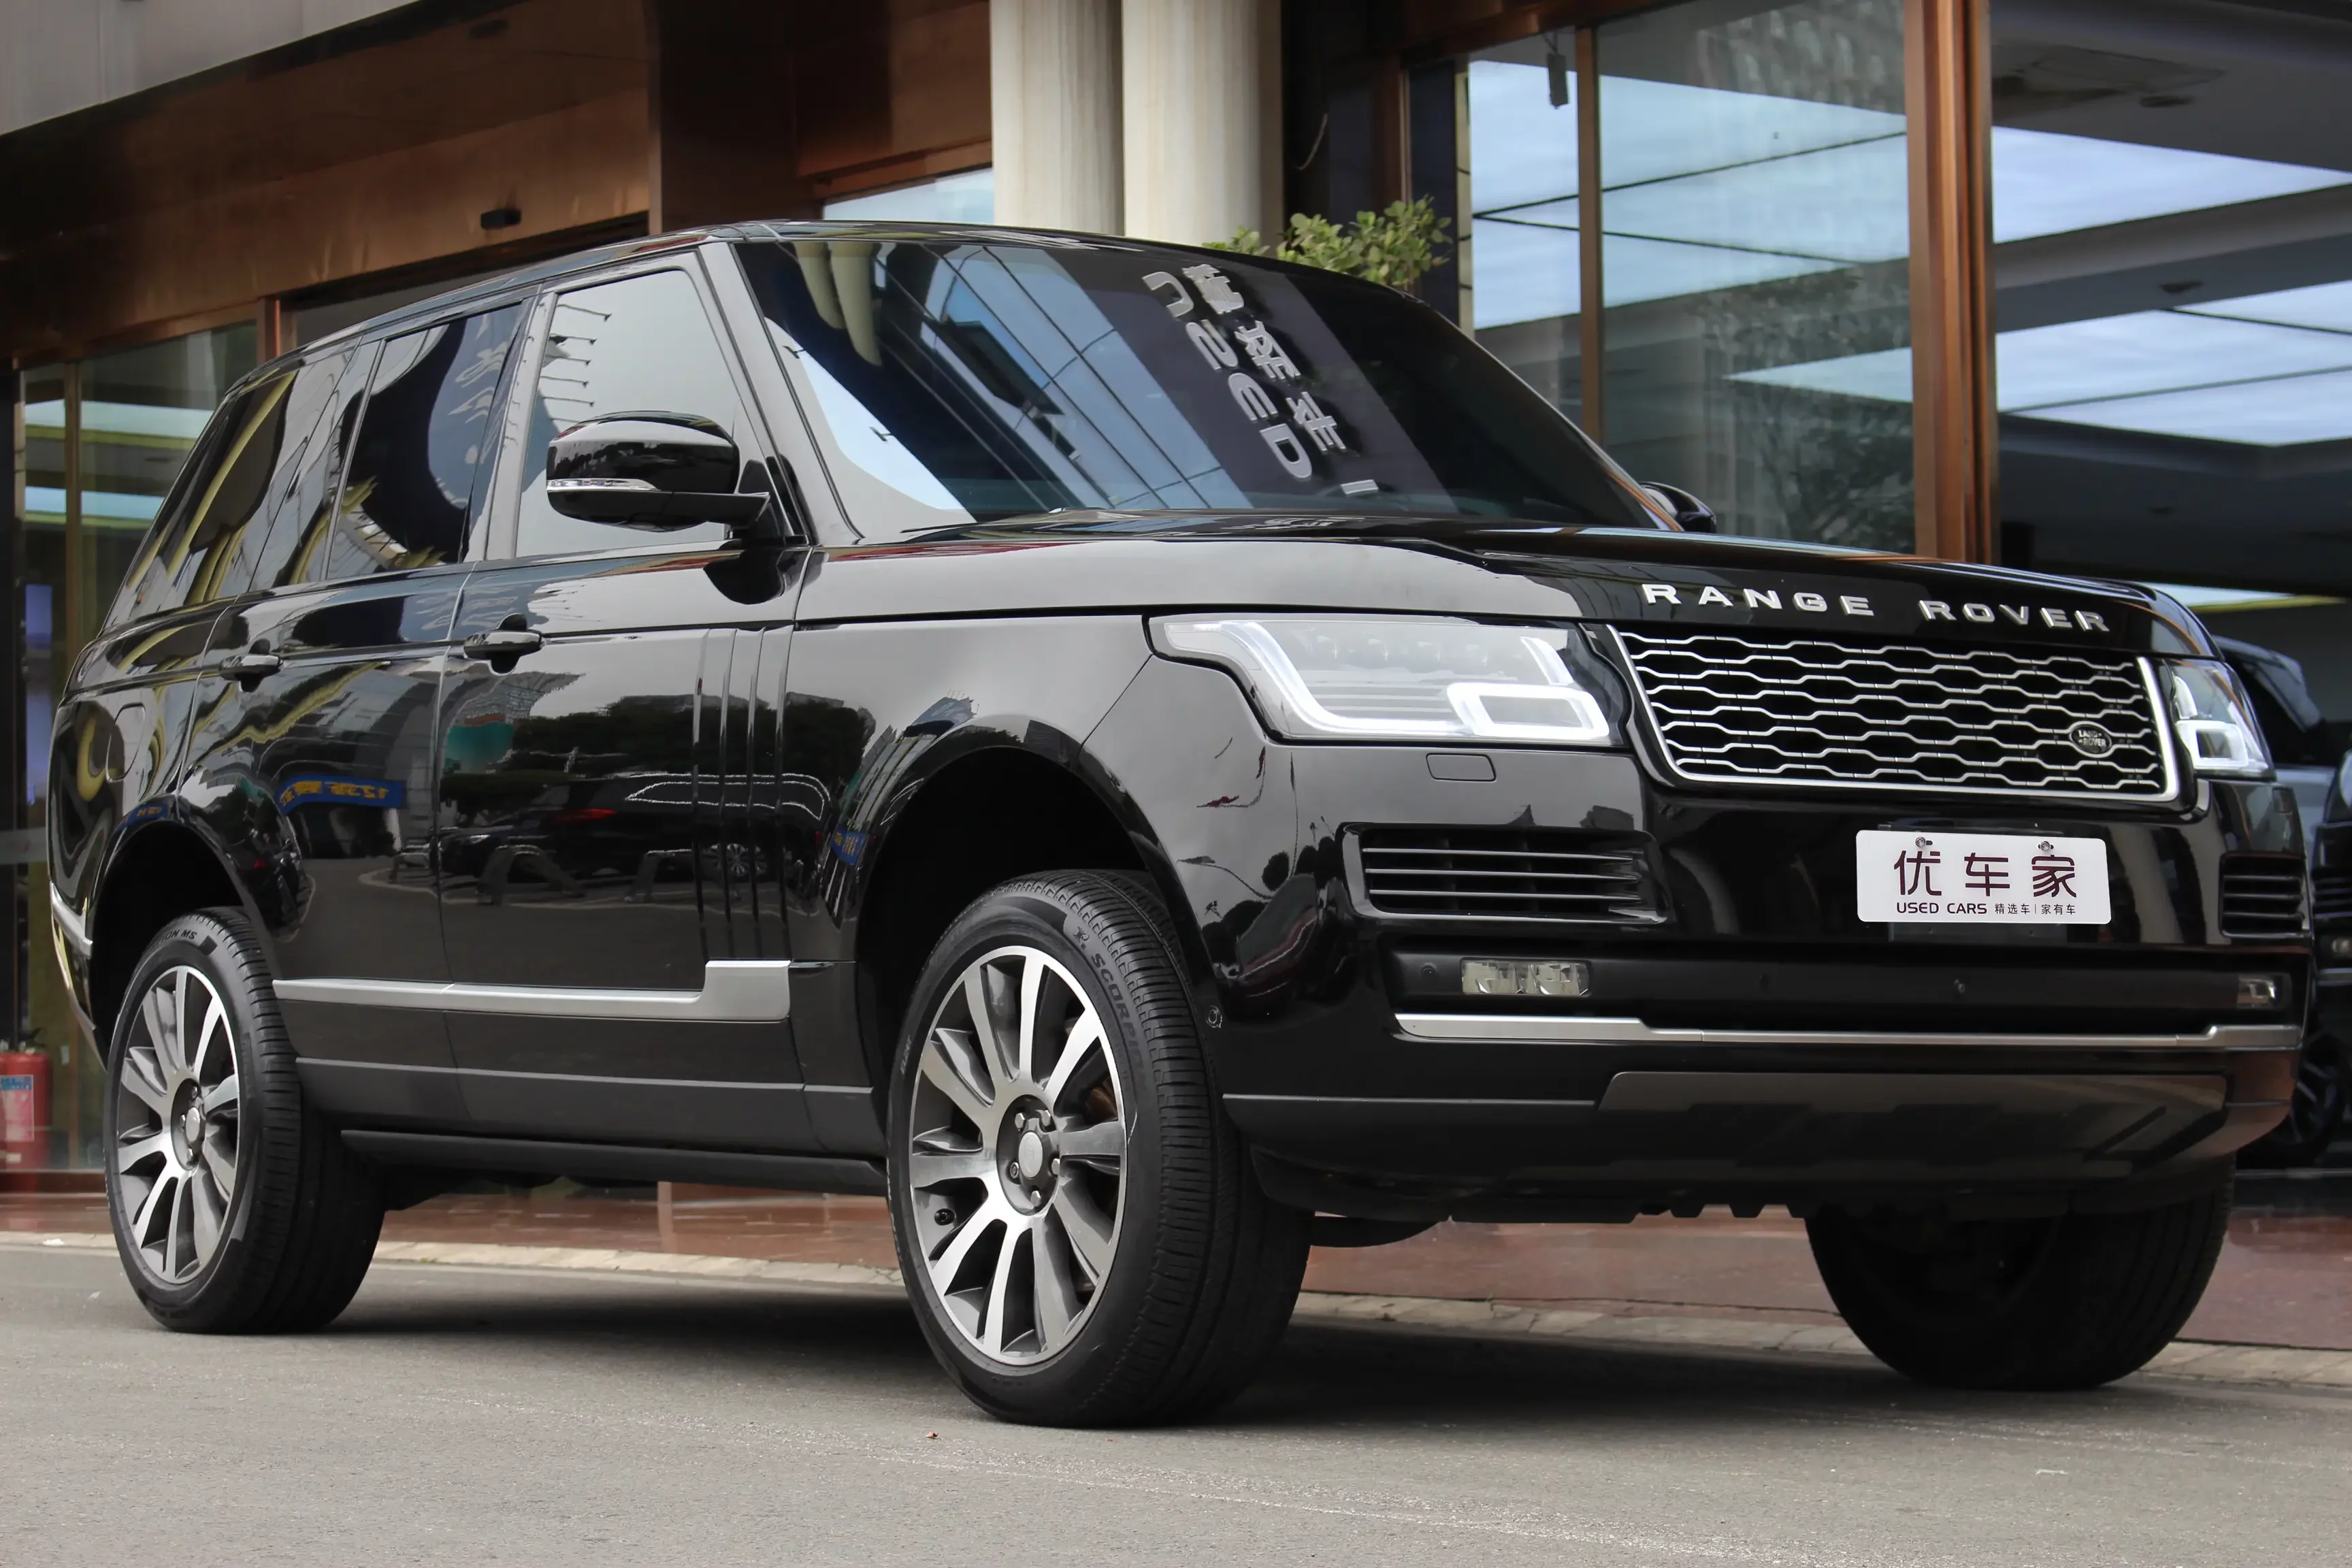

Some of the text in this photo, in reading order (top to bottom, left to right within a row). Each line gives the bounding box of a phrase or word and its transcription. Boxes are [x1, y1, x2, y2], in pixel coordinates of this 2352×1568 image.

[1641, 583, 2110, 632] RANGE ROVER
[2078, 730, 2098, 738] LAND
[2083, 738, 2106, 747] ROVER
[1893, 850, 2077, 898] 优车家
[1896, 902, 1987, 914] USED CARS
